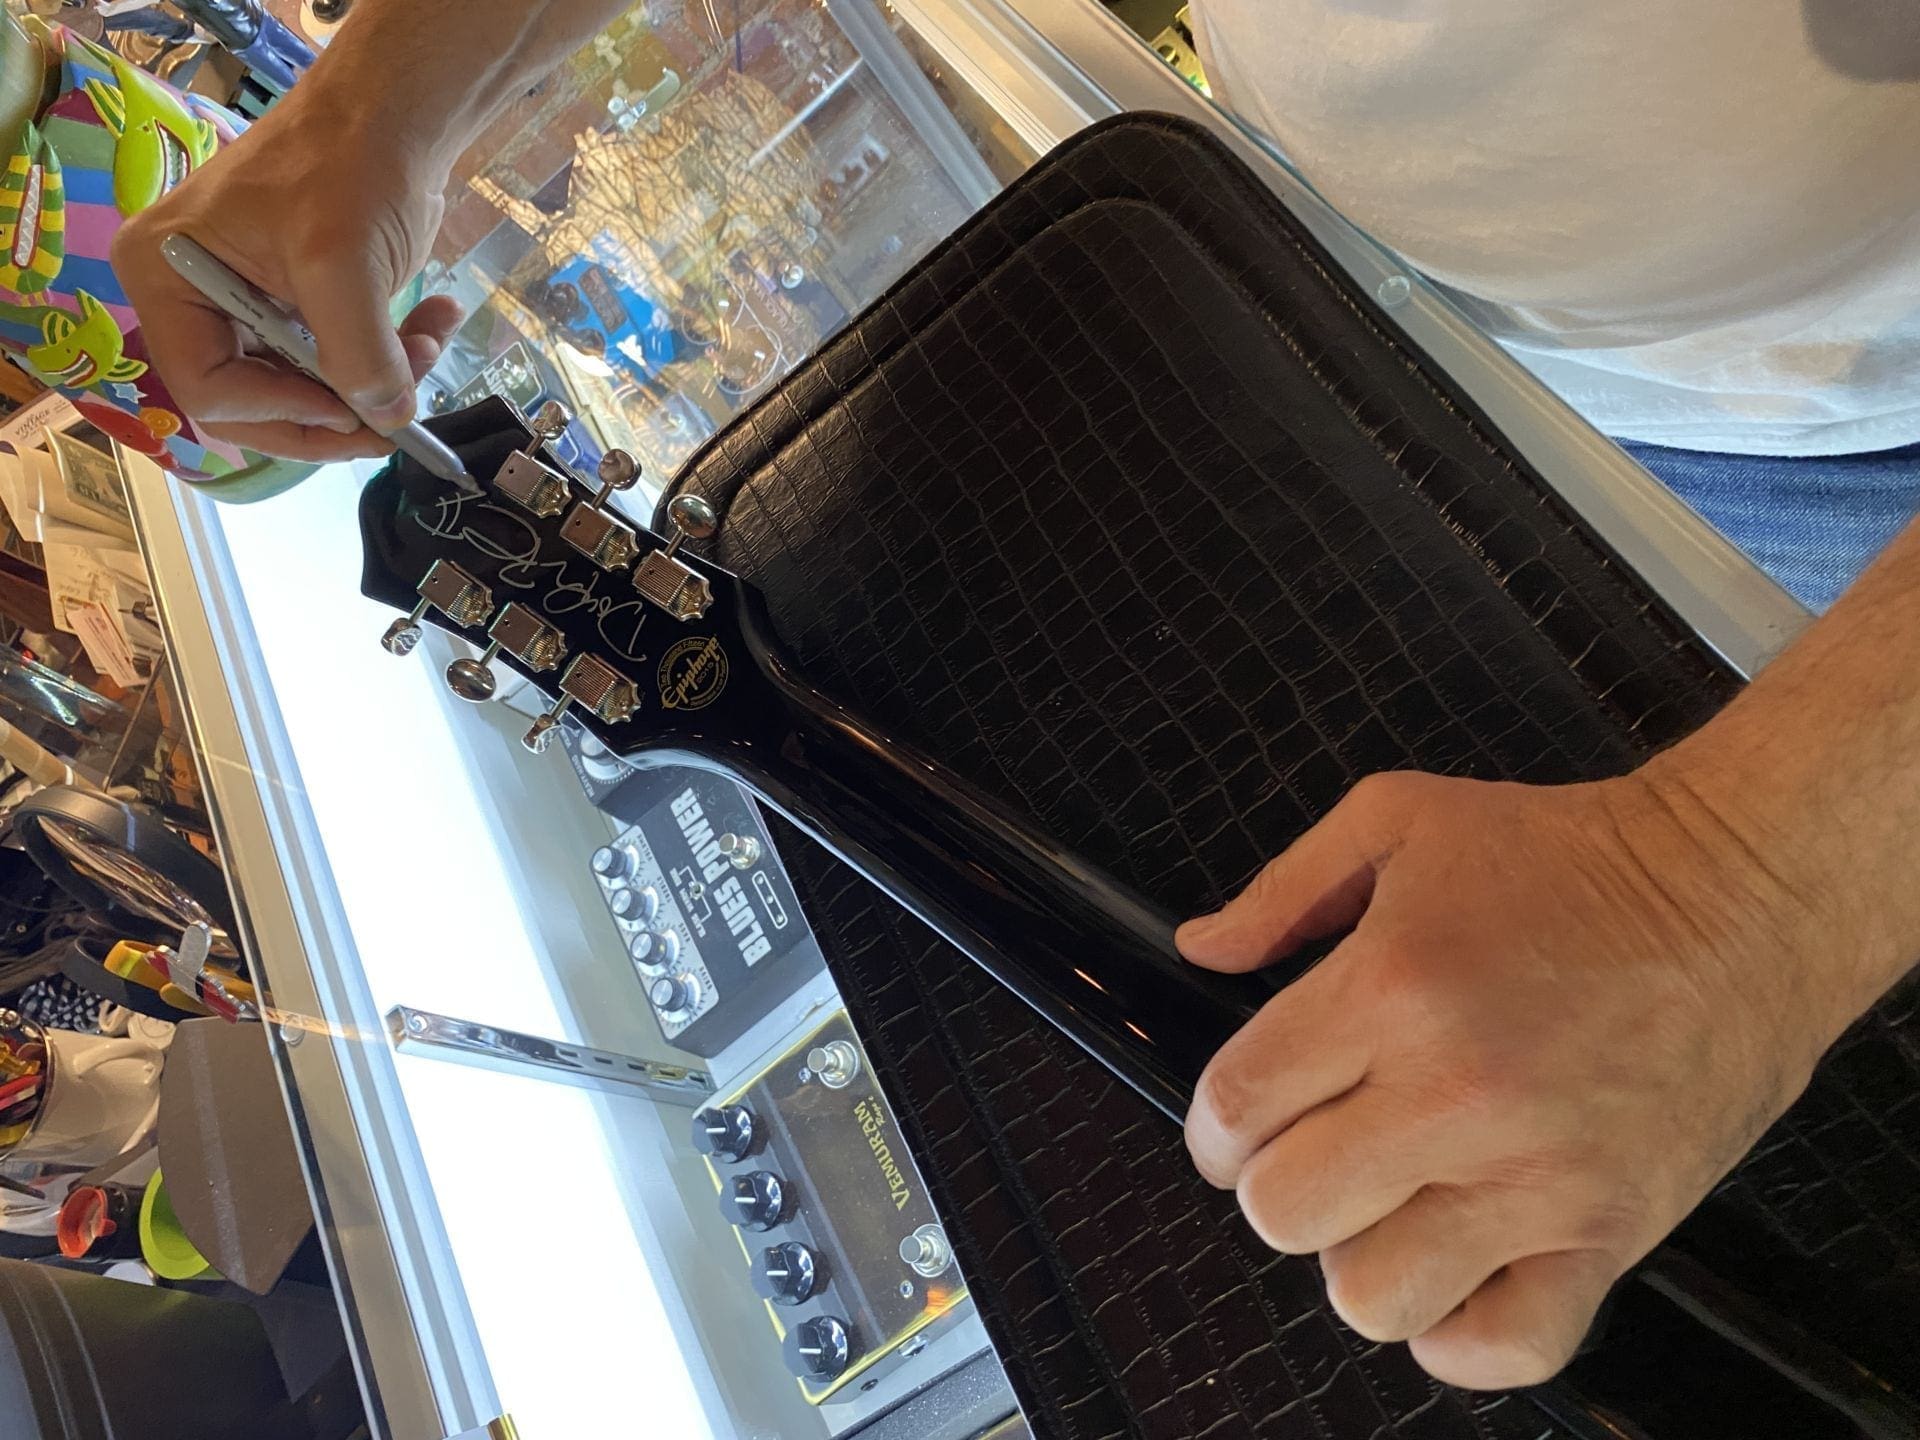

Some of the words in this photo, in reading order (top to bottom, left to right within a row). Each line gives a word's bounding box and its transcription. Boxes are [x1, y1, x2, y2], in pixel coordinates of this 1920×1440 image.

[661, 636, 720, 709] Epiphone
[670, 787, 730, 884] POWER
[713, 876, 772, 967] BLUES
[854, 1101, 910, 1211] VEMURAM
